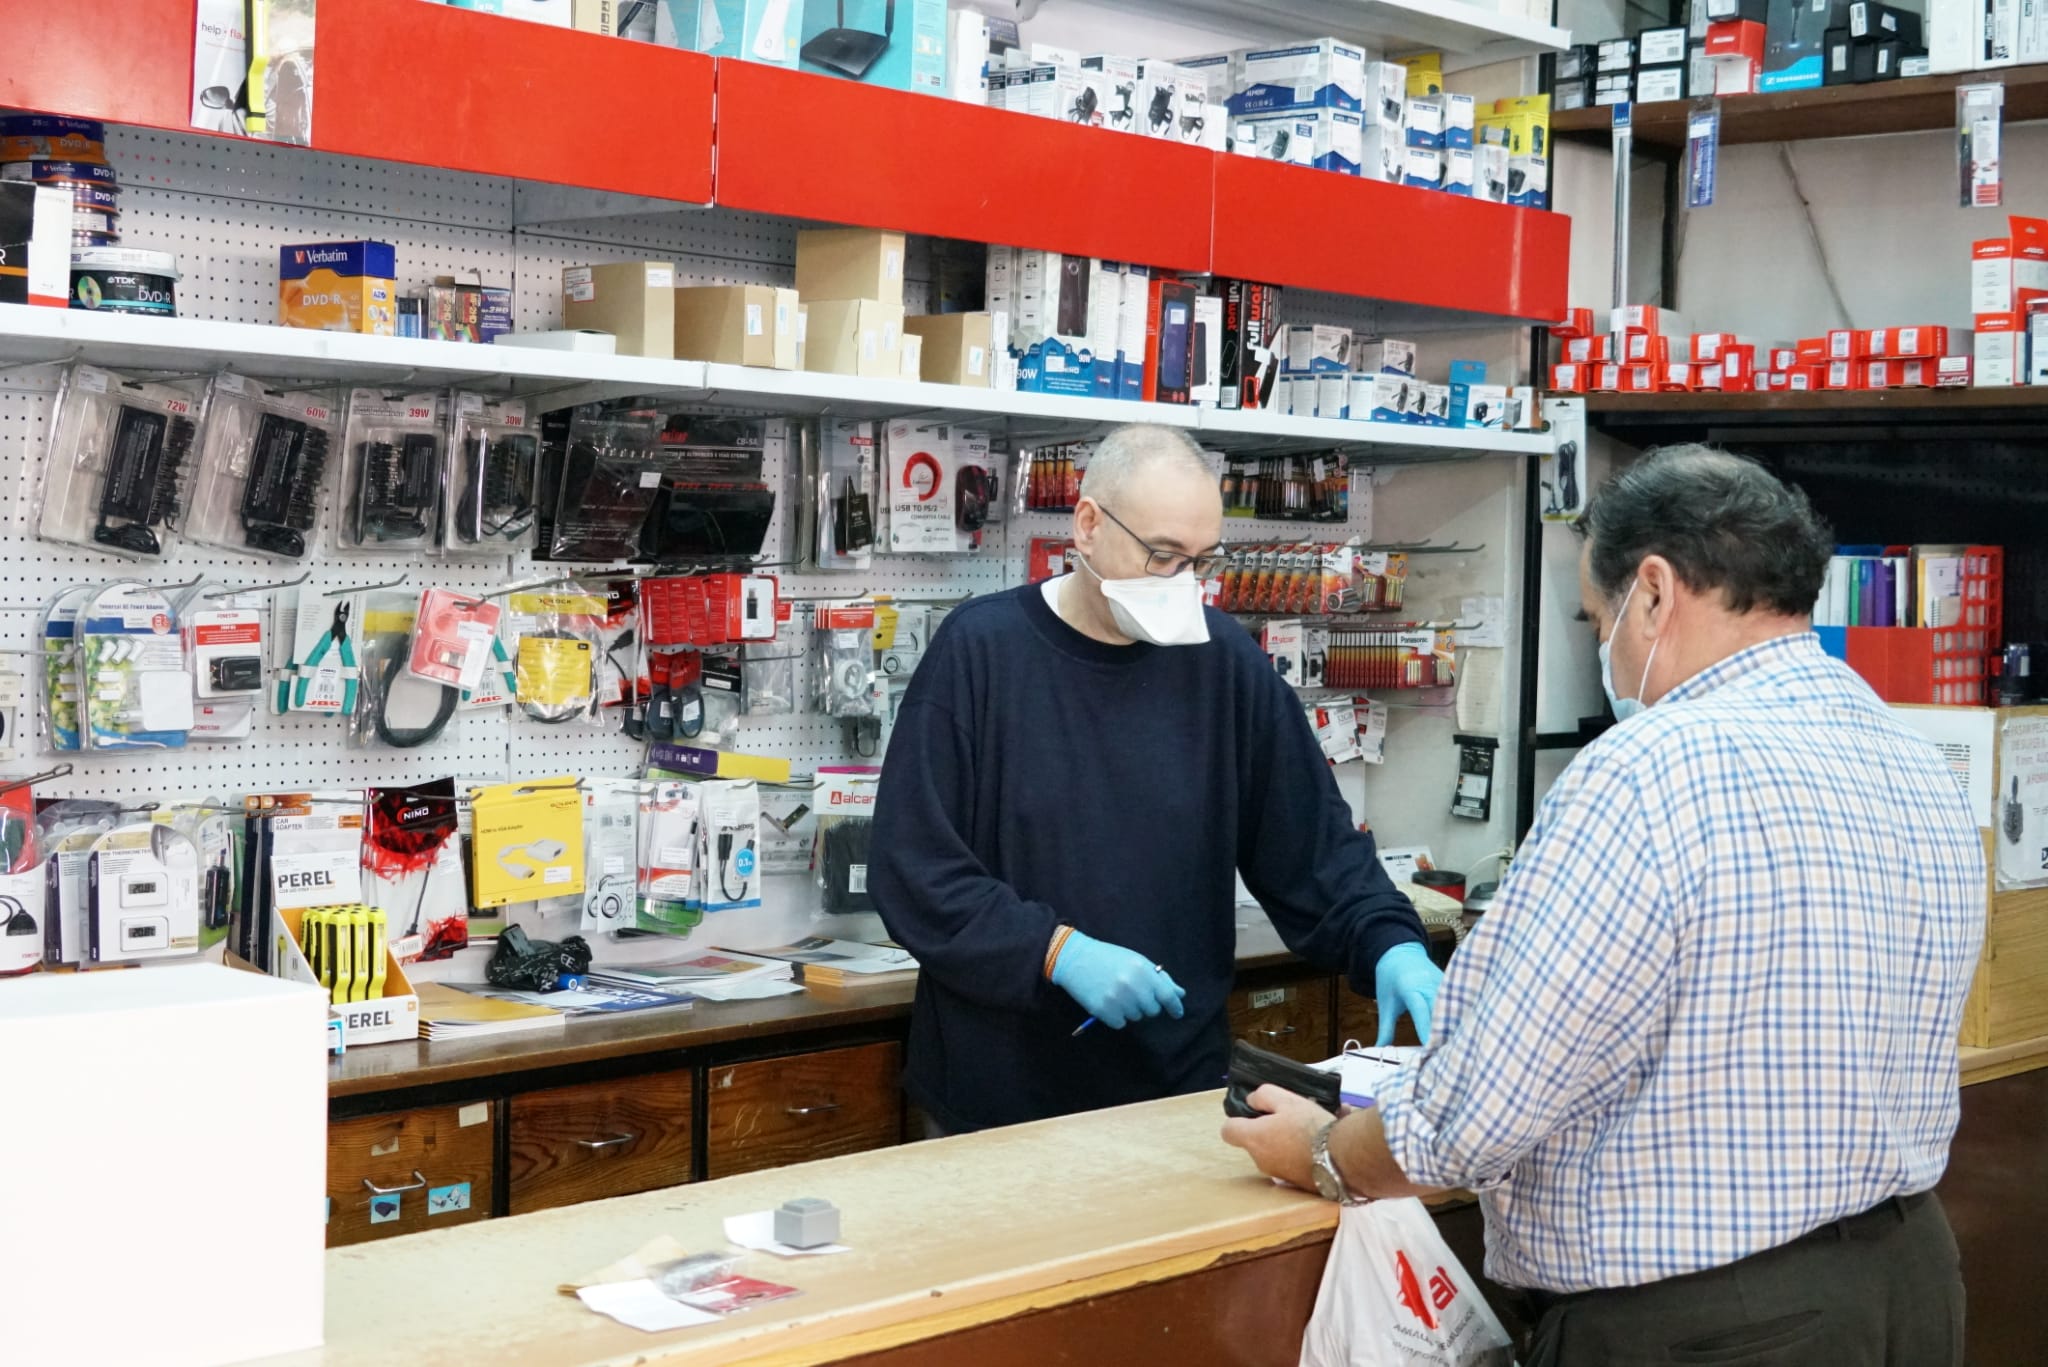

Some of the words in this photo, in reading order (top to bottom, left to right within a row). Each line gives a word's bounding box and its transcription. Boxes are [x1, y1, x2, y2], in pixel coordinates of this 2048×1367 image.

[201, 22, 221, 37] help
[230, 28, 245, 40] fla
[307, 248, 348, 264] Verbatim
[114, 277, 136, 285] TDK
[1226, 280, 1240, 331] fullwat
[1246, 282, 1262, 350] fullwat
[1016, 368, 1038, 380] 90W
[166, 400, 188, 413] 72W
[306, 406, 327, 420] 60W
[409, 407, 429, 418] 39W
[505, 415, 522, 425] 30W
[895, 504, 911, 512] USB
[913, 504, 922, 512] TO
[1400, 635, 1428, 644] Panasonic
[471, 695, 503, 704] JBC
[403, 807, 429, 820] NIMO
[278, 870, 334, 888] PEREL
[345, 1010, 394, 1029] EREL
